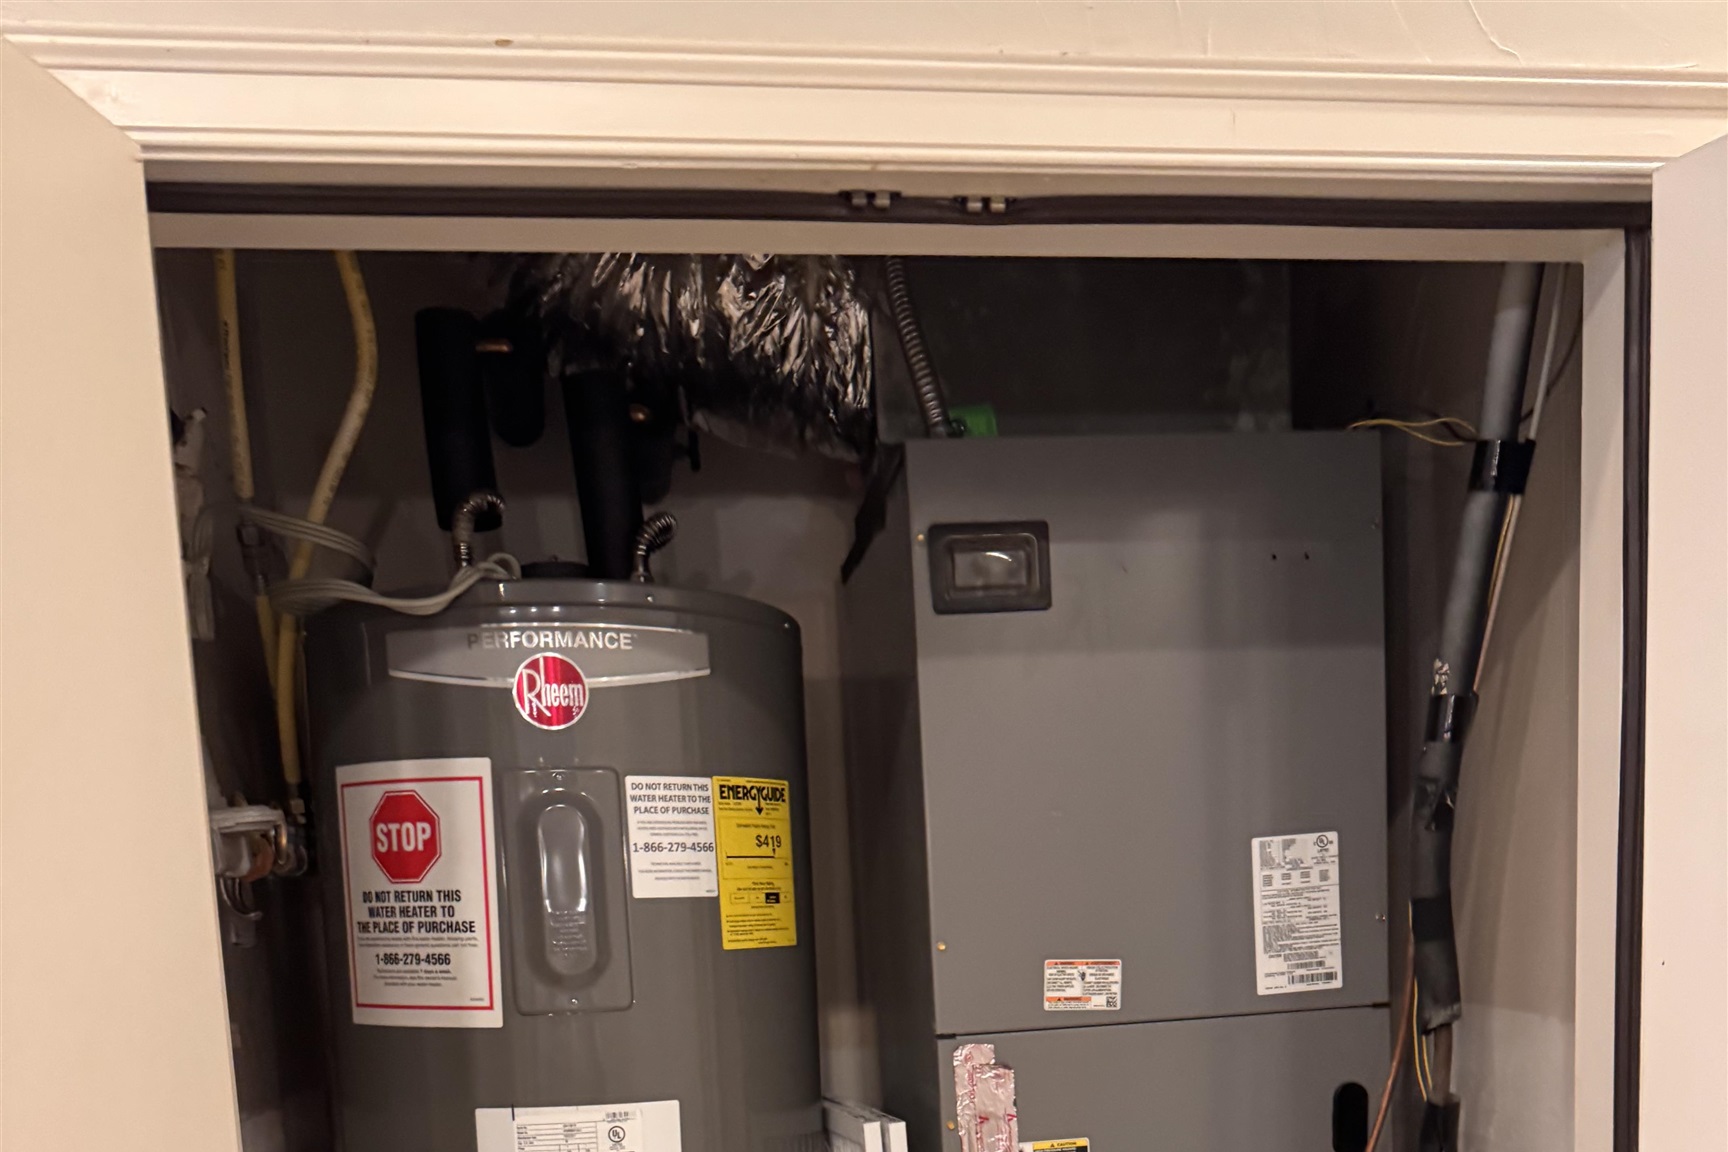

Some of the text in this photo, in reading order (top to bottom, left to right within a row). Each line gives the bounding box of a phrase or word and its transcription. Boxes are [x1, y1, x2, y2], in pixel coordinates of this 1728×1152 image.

[467, 630, 633, 650] PERFORMANCE
[521, 656, 585, 717] Rheem
[631, 783, 644, 791] DO
[645, 783, 662, 791] NOT
[663, 783, 692, 791] RETURN
[630, 794, 711, 804] WATER HEATER TO THE
[634, 807, 709, 815] PLACE OF PURCHASE
[376, 822, 432, 853] STOP
[755, 835, 782, 848] $419
[633, 842, 714, 853] 1-866-279-4566
[362, 889, 462, 904] DO NOT RETURN THIS
[368, 905, 455, 919] WATER HEATER TO
[357, 920, 476, 934] THE PLACE OF PURCHASE
[375, 953, 451, 966] 1-866-279-4566
